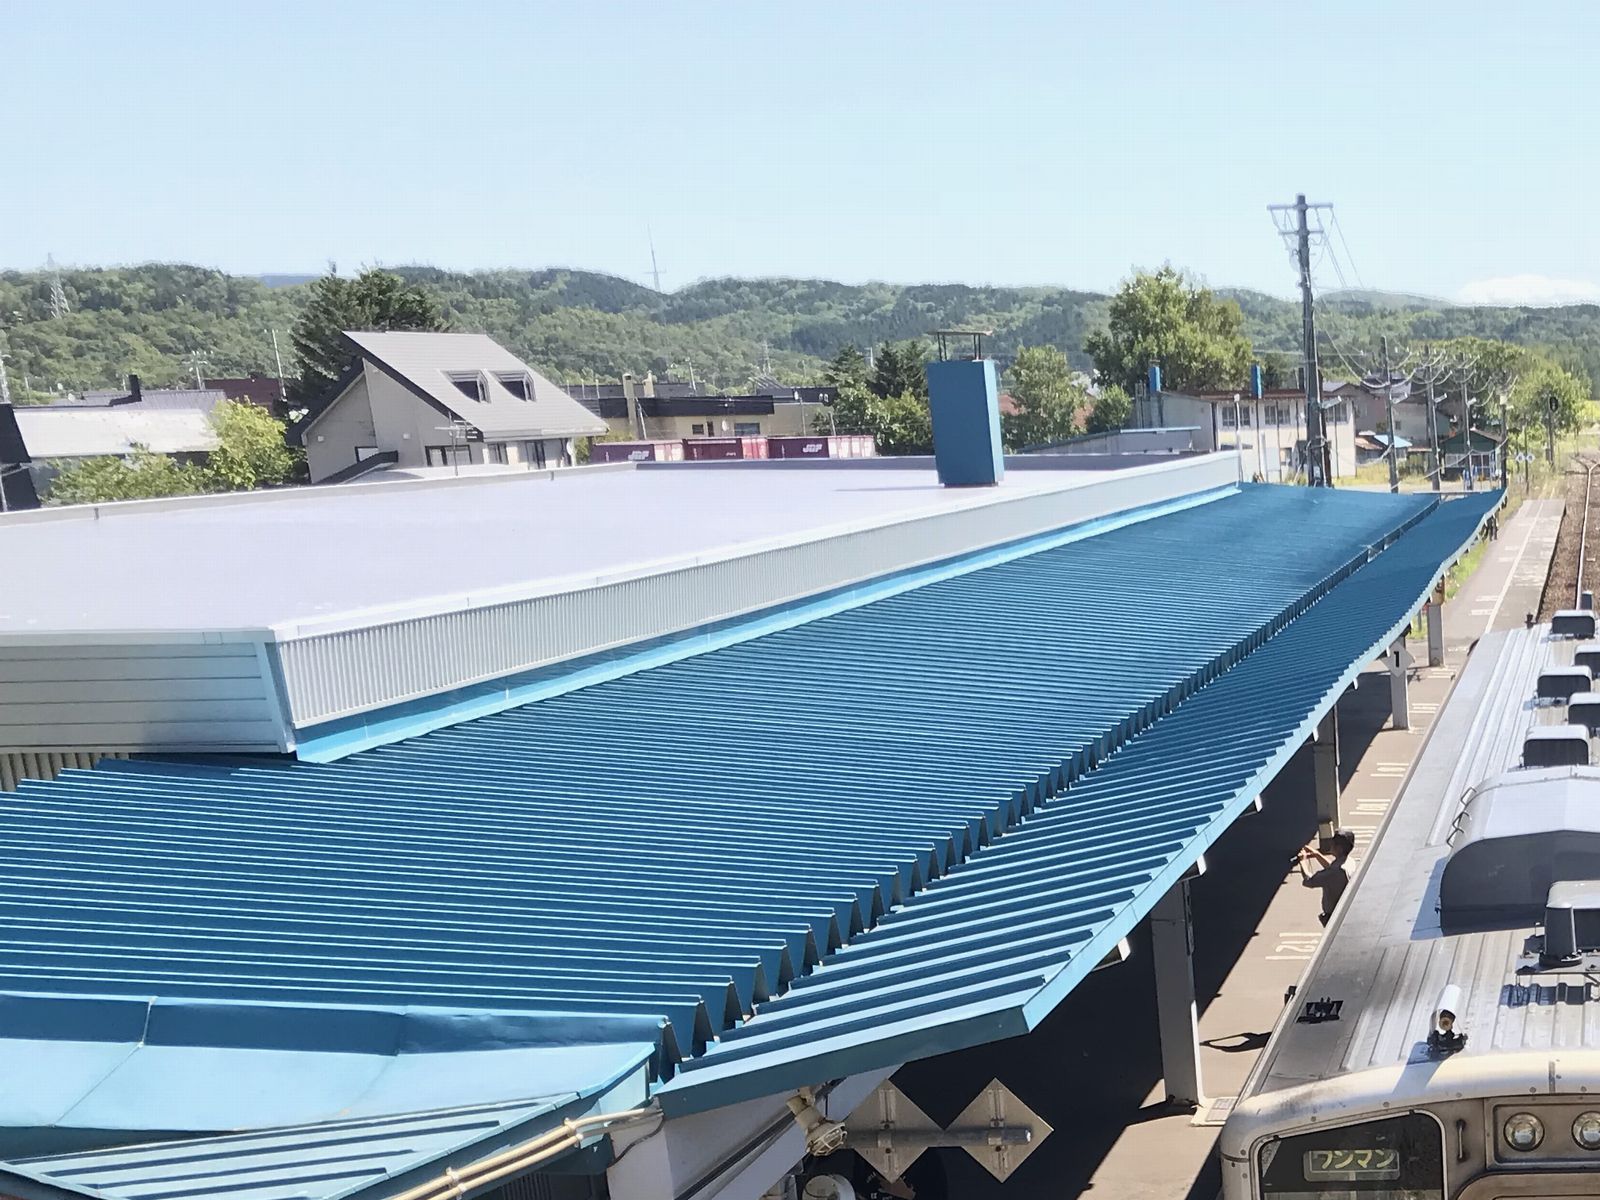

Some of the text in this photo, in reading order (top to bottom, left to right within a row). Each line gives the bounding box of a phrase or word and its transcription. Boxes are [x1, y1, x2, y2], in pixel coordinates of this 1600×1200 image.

[1393, 651, 1400, 668] 1
[1313, 1149, 1395, 1169] ワンマン
